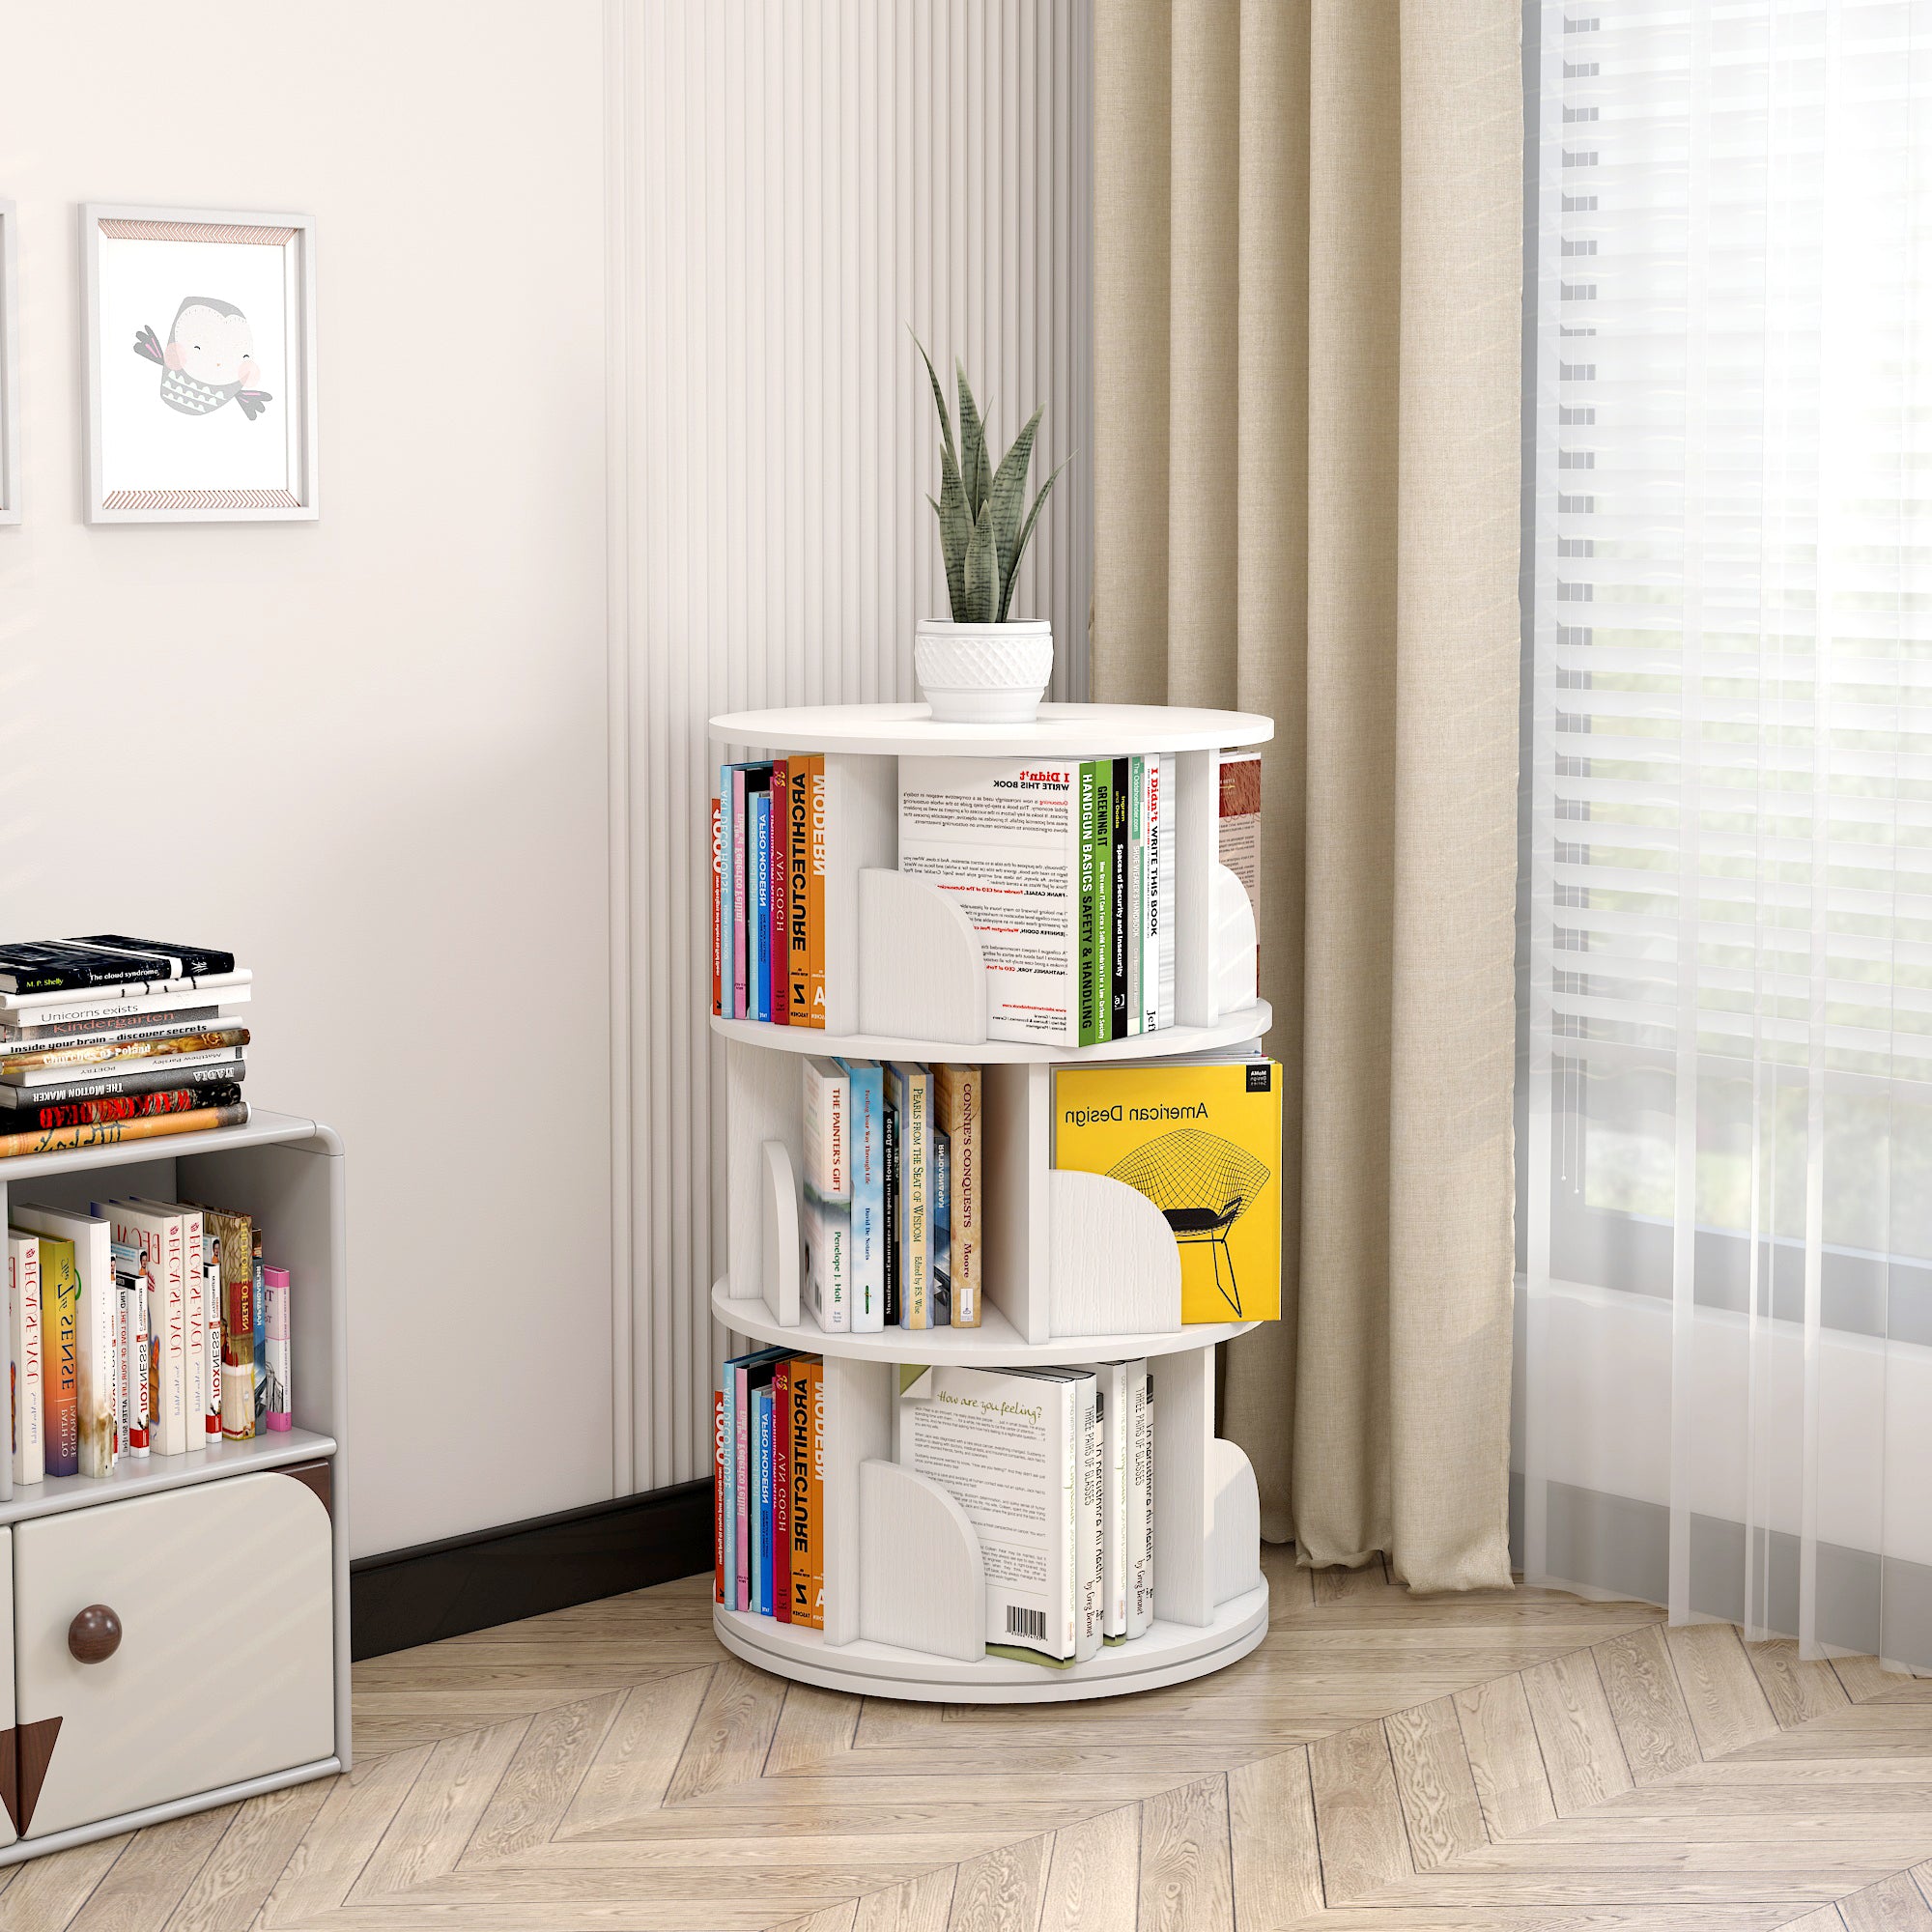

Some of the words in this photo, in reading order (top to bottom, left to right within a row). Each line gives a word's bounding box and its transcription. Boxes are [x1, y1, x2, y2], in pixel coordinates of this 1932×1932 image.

[1082, 773, 1093, 841] HANDGUN
[1097, 785, 1108, 836] GREENING
[1151, 778, 1159, 823] Didn't
[1097, 837, 1108, 847] IT
[1150, 826, 1158, 865] WRITE
[1082, 844, 1093, 893] BASICS
[1115, 843, 1124, 872] Spaces
[1115, 873, 1124, 883] of
[1150, 868, 1158, 896] THIS
[1115, 883, 1124, 916] Security
[1081, 895, 1093, 943] SAFETY
[1115, 916, 1123, 934] and
[1150, 900, 1158, 937] BOOK
[1081, 948, 1093, 958] &
[1114, 935, 1123, 978] Insecurity
[89, 972, 103, 981] The
[103, 970, 125, 980] cloud
[124, 968, 159, 979] syndrome
[1081, 960, 1093, 1030] HANDLING
[41, 1009, 100, 1023] Unicorns
[102, 1004, 138, 1016] exists
[52, 1010, 175, 1034] Kindergarten
[10, 1040, 46, 1054] Inside
[47, 1038, 75, 1052] your
[76, 1035, 106, 1046] brain
[116, 1029, 165, 1043] discover
[165, 1023, 208, 1037] secrets
[43, 1049, 98, 1065] Churches
[114, 1043, 152, 1058] Poland
[80, 1065, 116, 1075] POETRY
[832, 1088, 841, 1110] THE
[912, 1088, 923, 1120] PEARLS
[963, 1083, 972, 1146] CONNIE'S
[832, 1112, 841, 1166] PAINTER'S
[884, 1118, 894, 1146] Дозор
[913, 1122, 923, 1144] FROM
[913, 1148, 923, 1165] THE
[832, 1168, 841, 1192] GIFT
[912, 1166, 923, 1191] SEAT
[962, 1153, 972, 1228] CONQUESTS
[913, 1191, 923, 1203] OF
[865, 1227, 871, 1236] De
[912, 1206, 923, 1243] WISDOM
[832, 1231, 842, 1272] Penelope
[963, 1243, 972, 1278] Moore
[914, 1256, 923, 1276] Edited
[834, 1283, 842, 1303] Holt
[914, 1297, 923, 1315] Wise
[936, 1390, 958, 1406] How
[959, 1398, 979, 1407] are
[980, 1401, 1001, 1415] you
[1000, 1402, 1042, 1426] feeling?
[1135, 1386, 1145, 1413] THREE
[1084, 1405, 1094, 1432] THREE
[1135, 1414, 1145, 1437] PAIRS
[1084, 1434, 1094, 1457] PAIRS
[1135, 1439, 1145, 1450] OF
[1084, 1458, 1094, 1468] OF
[1135, 1451, 1145, 1486] GLASSES
[1084, 1470, 1094, 1507] GLASSES
[1134, 1559, 1146, 1569] by
[1083, 1580, 1095, 1591] by
[1133, 1570, 1146, 1589] Greg
[1083, 1591, 1095, 1611] Greg
[1136, 1590, 1146, 1616] Bennet
[1086, 1611, 1094, 1638] Bennet
